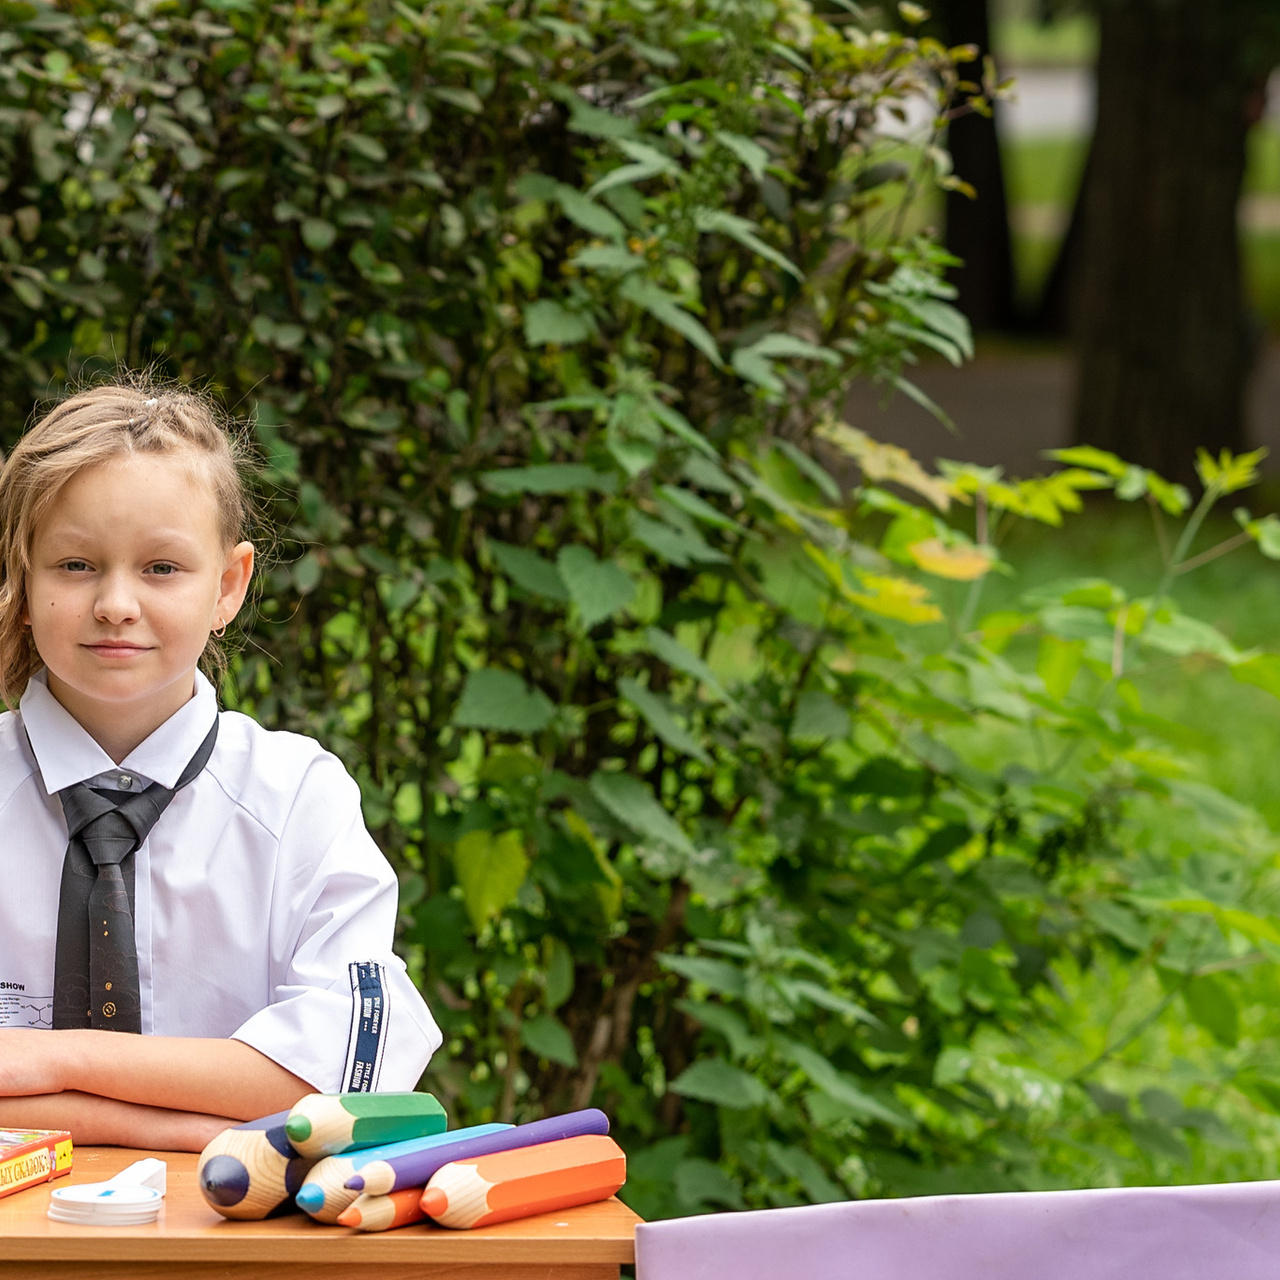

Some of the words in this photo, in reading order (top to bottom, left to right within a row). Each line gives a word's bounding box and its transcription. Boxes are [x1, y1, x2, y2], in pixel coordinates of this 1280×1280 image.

[0, 982, 25, 991] SHOW
[371, 1009, 380, 1034] FOREVER
[352, 1061, 364, 1088] FASHION
[363, 1062, 372, 1079] STYLE
